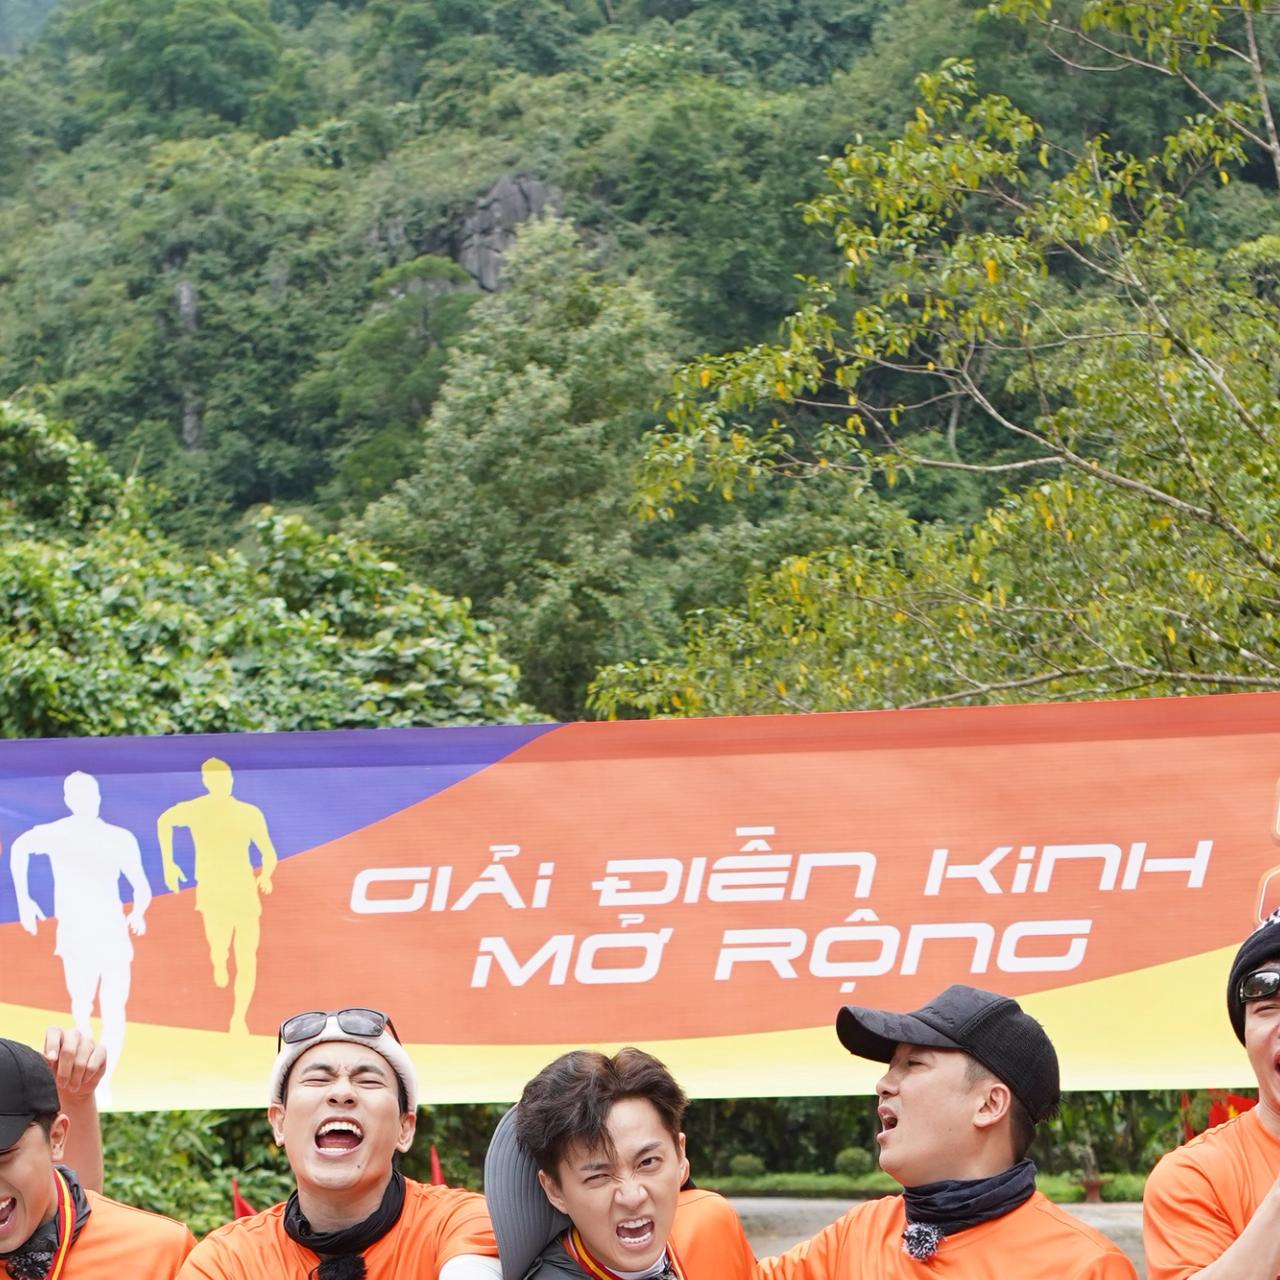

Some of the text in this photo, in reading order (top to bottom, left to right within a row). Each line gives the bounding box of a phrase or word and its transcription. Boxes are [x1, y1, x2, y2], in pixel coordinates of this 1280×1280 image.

[349, 843, 555, 914] GIẢI
[470, 908, 1093, 994] MỞ RỘNG
